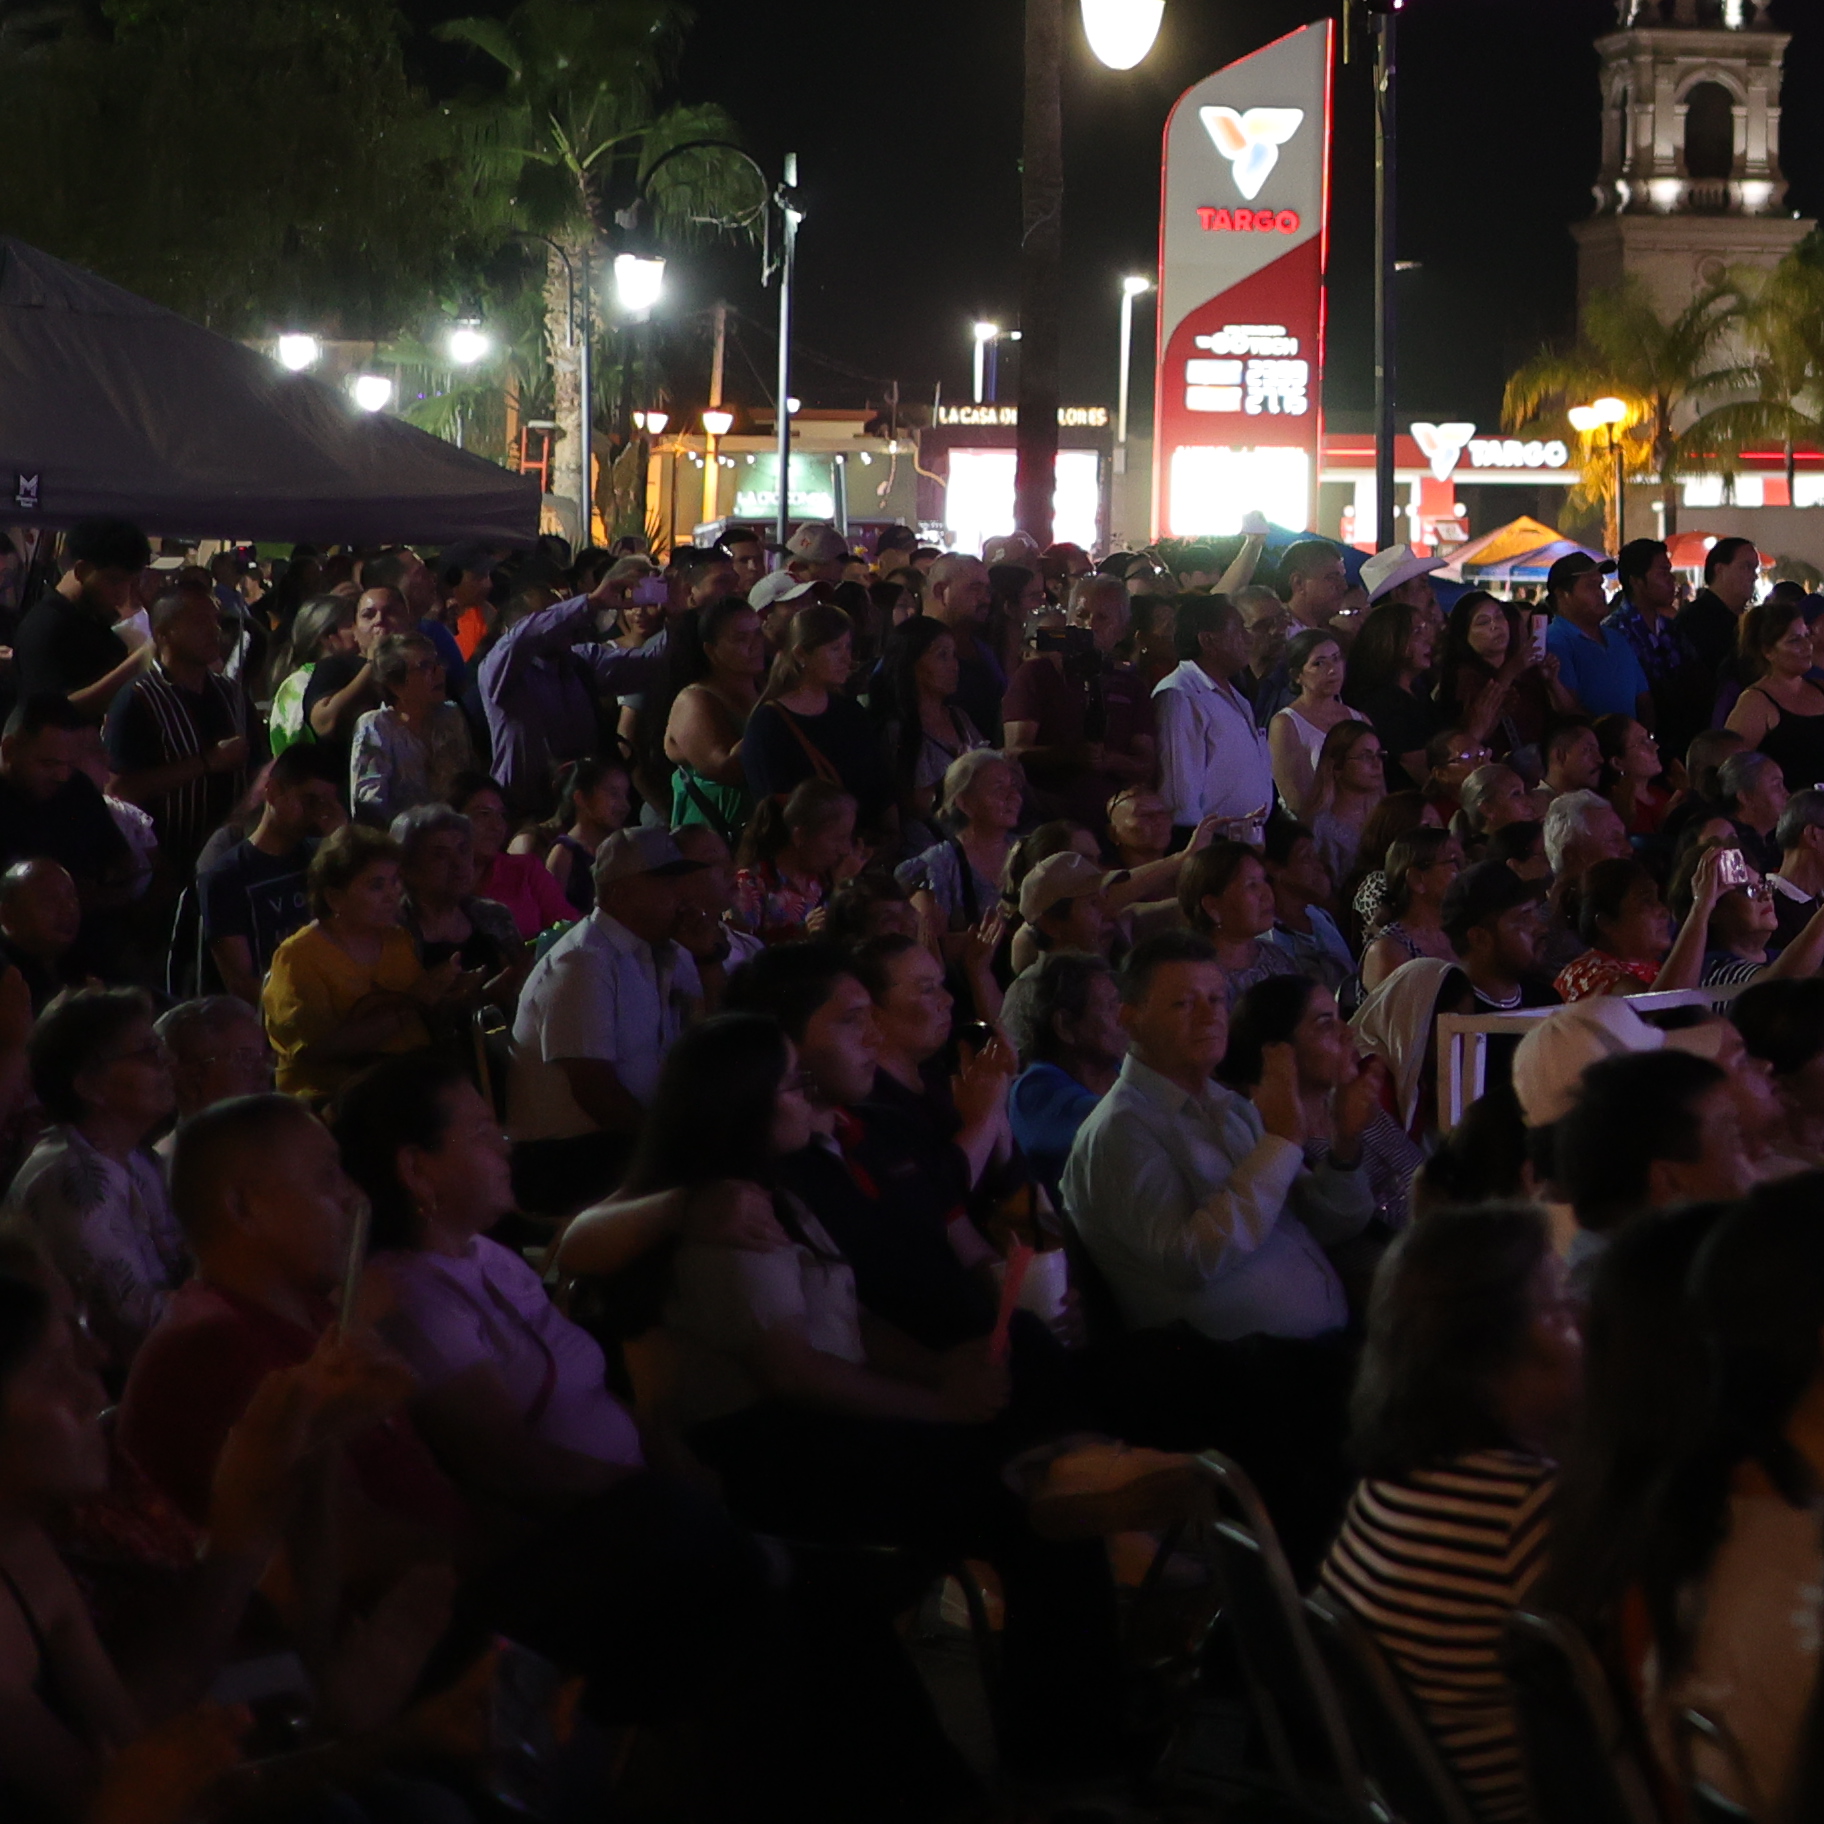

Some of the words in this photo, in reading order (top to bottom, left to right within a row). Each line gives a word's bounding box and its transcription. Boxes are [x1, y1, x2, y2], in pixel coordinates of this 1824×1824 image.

[1196, 206, 1300, 235] TARGO
[939, 406, 958, 424] LA
[960, 406, 997, 424] CASA
[1468, 439, 1568, 467] TARGO
